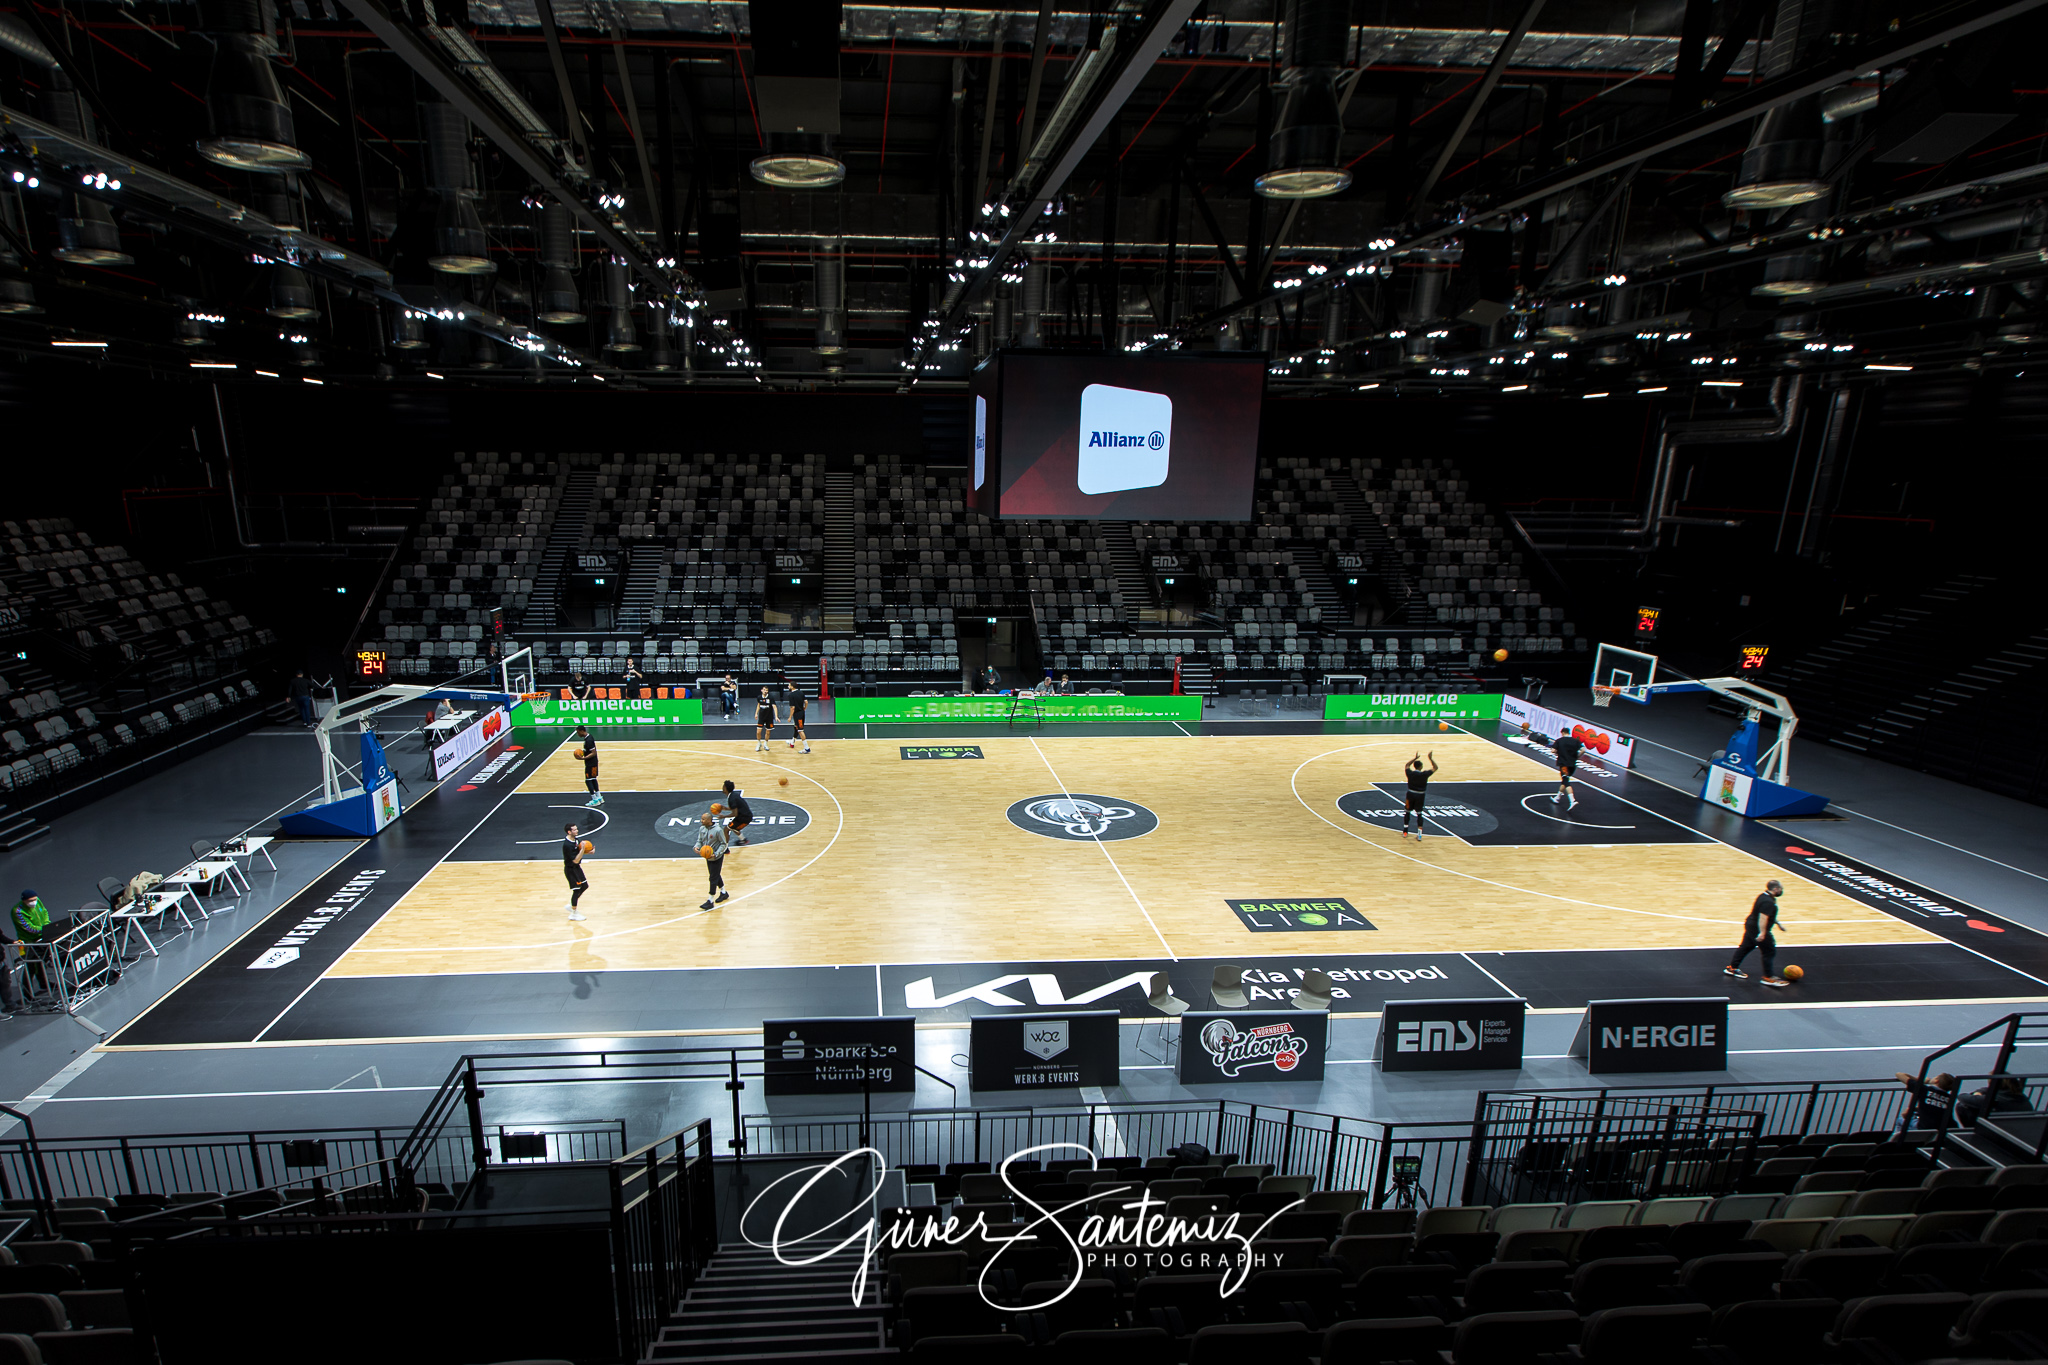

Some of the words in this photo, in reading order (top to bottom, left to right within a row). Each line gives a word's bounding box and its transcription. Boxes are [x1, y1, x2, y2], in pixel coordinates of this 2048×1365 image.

[1088, 431, 1145, 448] Allianz
[577, 555, 607, 567] EMS
[775, 555, 804, 567] EMS
[1152, 555, 1179, 567] EMS
[1638, 617, 1655, 631] 24
[357, 651, 386, 661] 49:41
[1742, 655, 1764, 668] 24
[363, 661, 383, 674] 24
[1504, 702, 1526, 719] Wilson
[1528, 707, 1547, 731] EVO
[436, 751, 455, 768] Wilson
[455, 734, 470, 761] EVO
[325, 869, 387, 903] EVENTS
[1805, 857, 1968, 918] LIEBLINGSSTADT
[1239, 902, 1346, 913] BARMER
[1241, 968, 1290, 984] Kia
[1250, 985, 1352, 1001] Area
[1256, 1024, 1289, 1037] NÜRNBERG
[1484, 1019, 1506, 1028] Experts
[1397, 1020, 1477, 1053] EMS
[1484, 1027, 1511, 1036] Managed
[1483, 1035, 1508, 1043] Services
[1213, 1032, 1292, 1066] Falcons
[815, 1064, 892, 1082] Nürnberg
[1014, 1072, 1045, 1085] WERK:B
[1048, 1071, 1080, 1083] EVENTS
